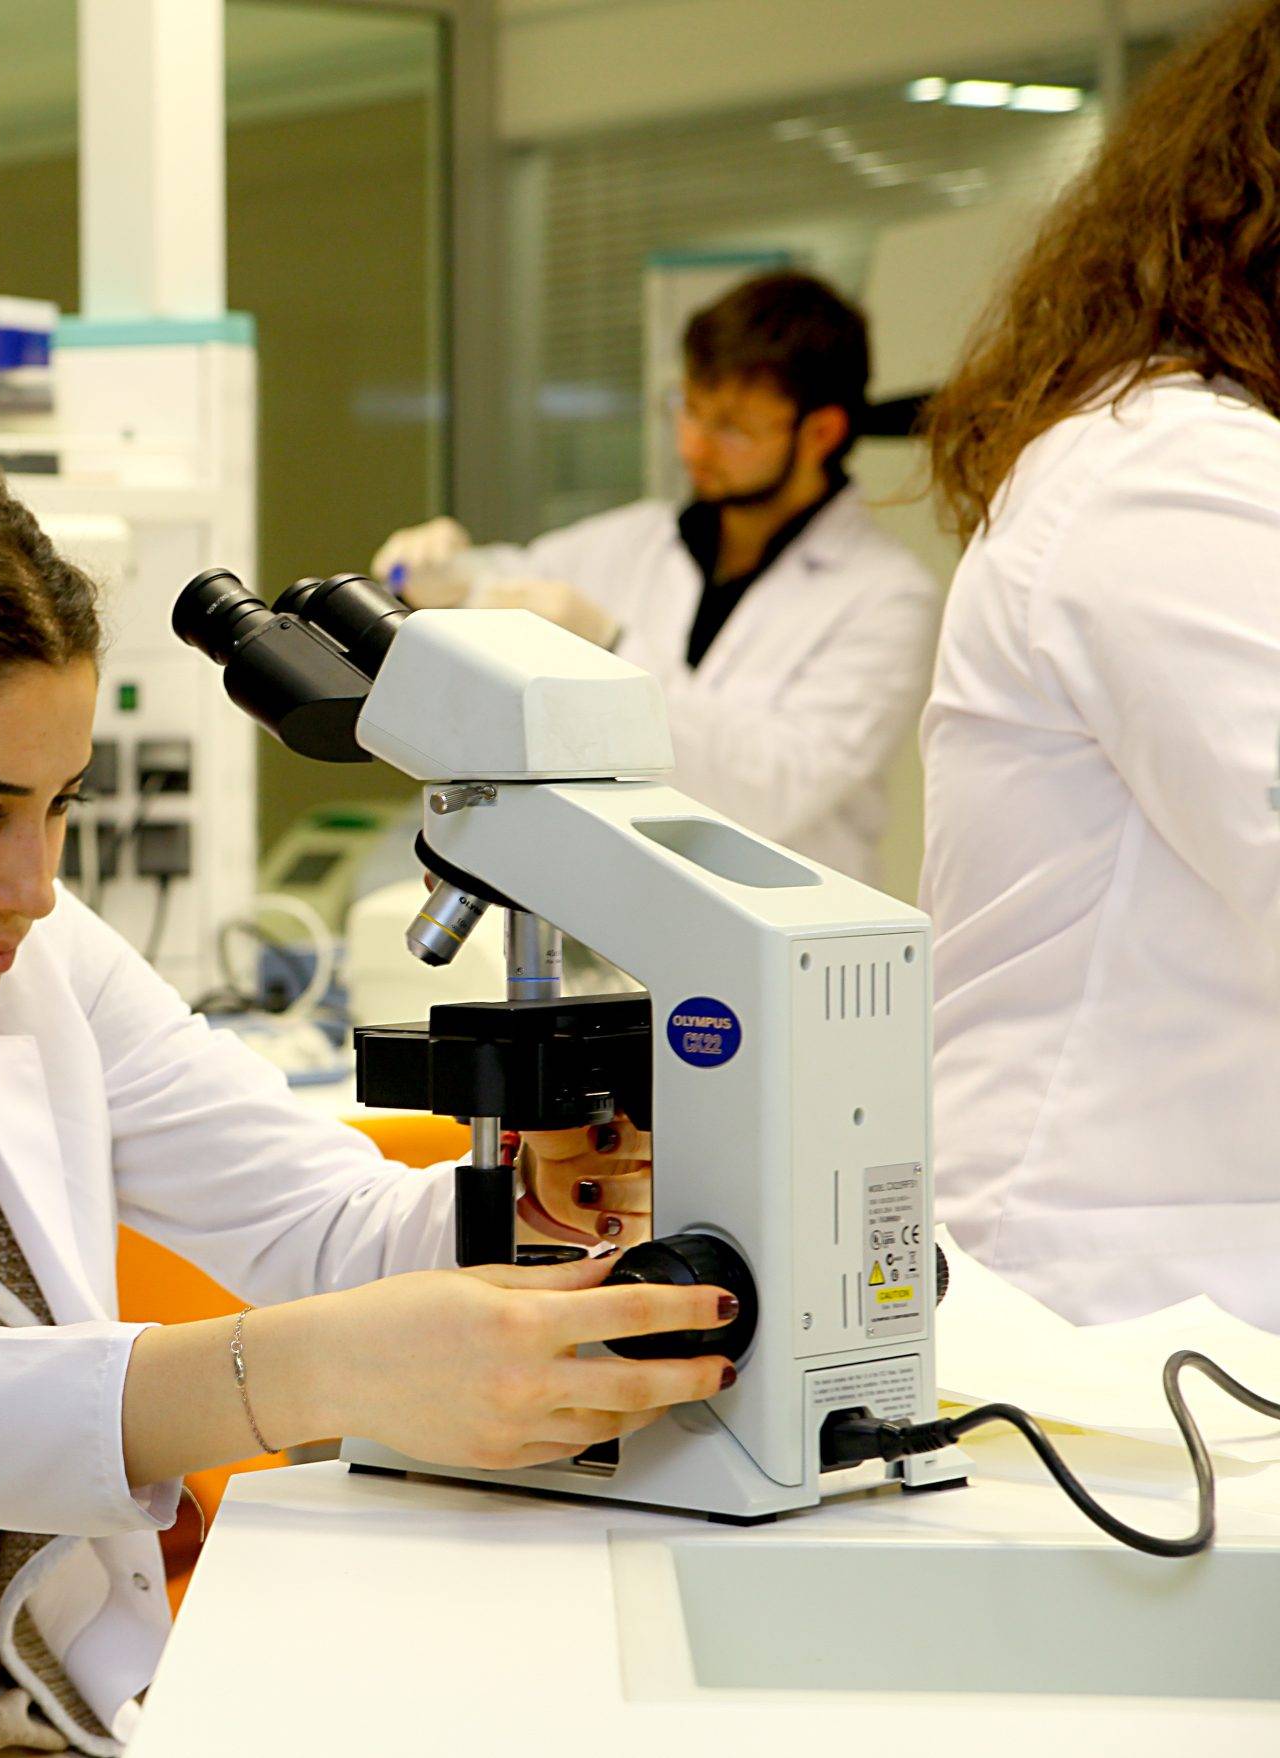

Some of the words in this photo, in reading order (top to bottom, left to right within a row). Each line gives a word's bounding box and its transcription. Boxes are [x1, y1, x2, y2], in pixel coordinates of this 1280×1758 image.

[672, 1015, 732, 1029] OLYMPUS
[682, 1032, 722, 1054] CX22
[902, 1224, 920, 1245] CE
